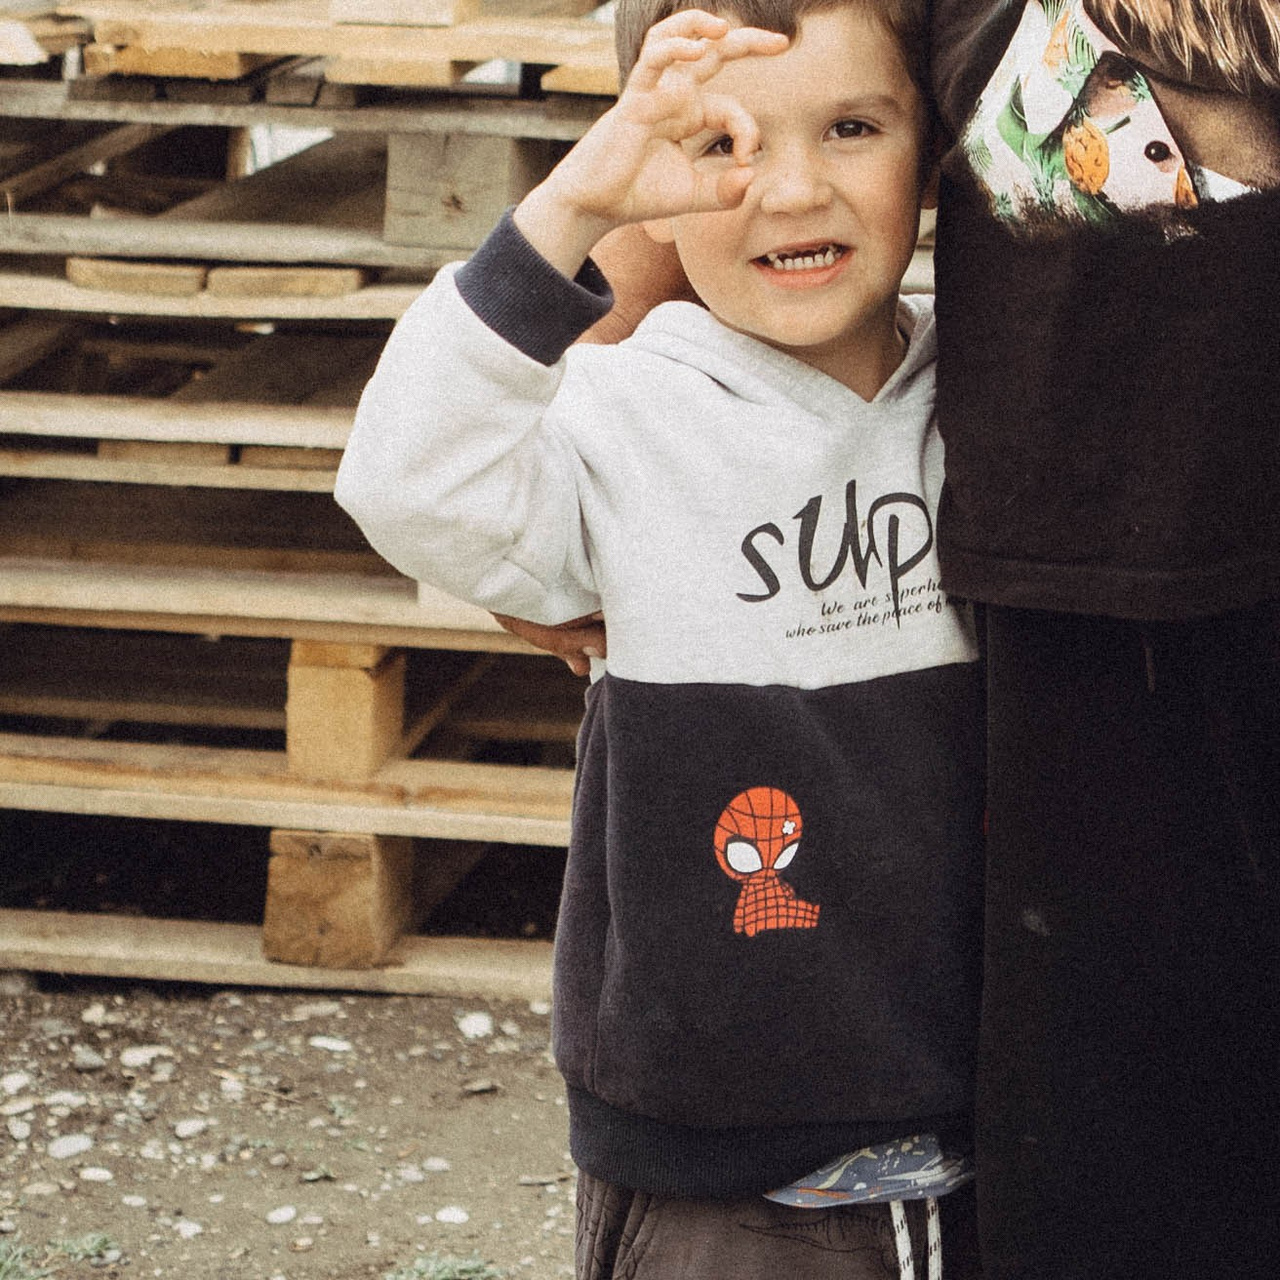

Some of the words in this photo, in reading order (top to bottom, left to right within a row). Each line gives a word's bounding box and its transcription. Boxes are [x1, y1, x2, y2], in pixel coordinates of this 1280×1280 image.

[820, 619, 852, 635] save
[856, 611, 880, 627] the
[927, 594, 942, 615] of
[821, 601, 844, 616] We
[853, 596, 878, 612] are
